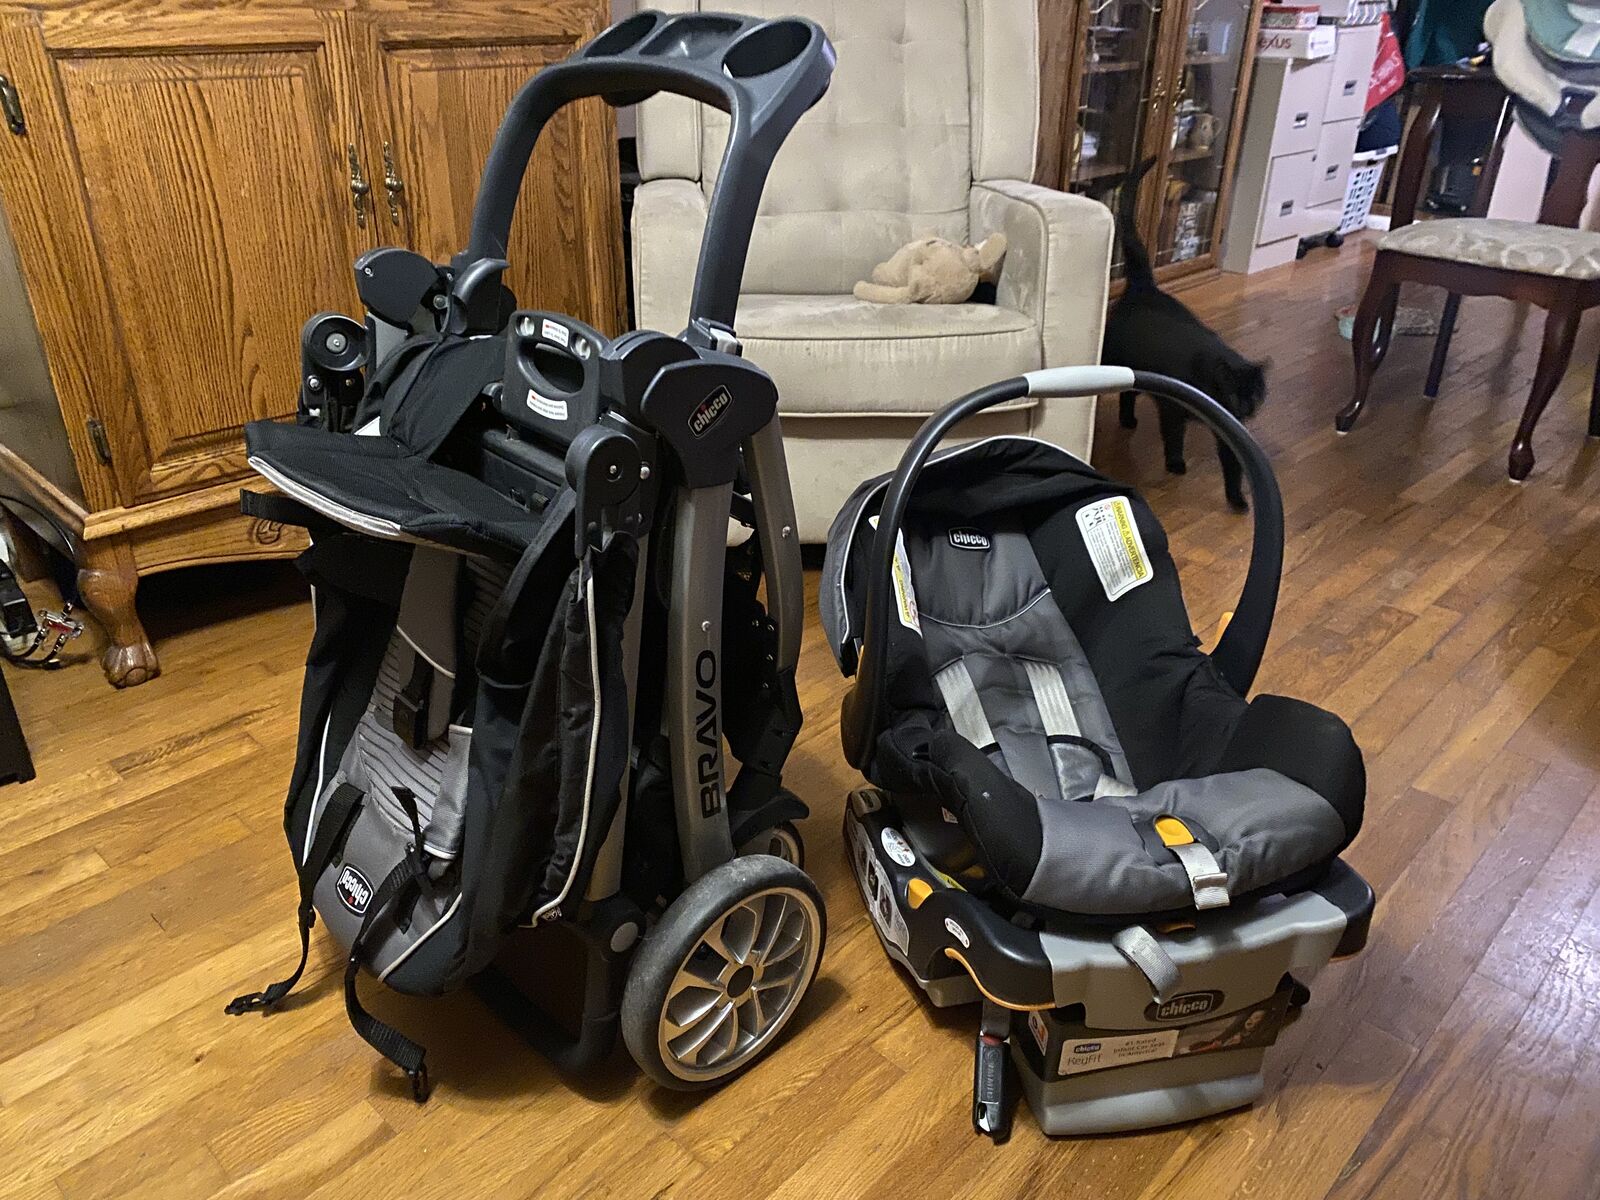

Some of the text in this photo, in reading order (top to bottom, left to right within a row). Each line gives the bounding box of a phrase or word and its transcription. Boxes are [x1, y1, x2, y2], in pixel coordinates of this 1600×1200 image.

[693, 392, 728, 432] chicco
[953, 530, 988, 546] chicco
[1125, 537, 1145, 578] ADVERTENCIA
[696, 649, 722, 819] BRAVO
[340, 869, 370, 906] chicco
[1160, 1000, 1209, 1017] chicco
